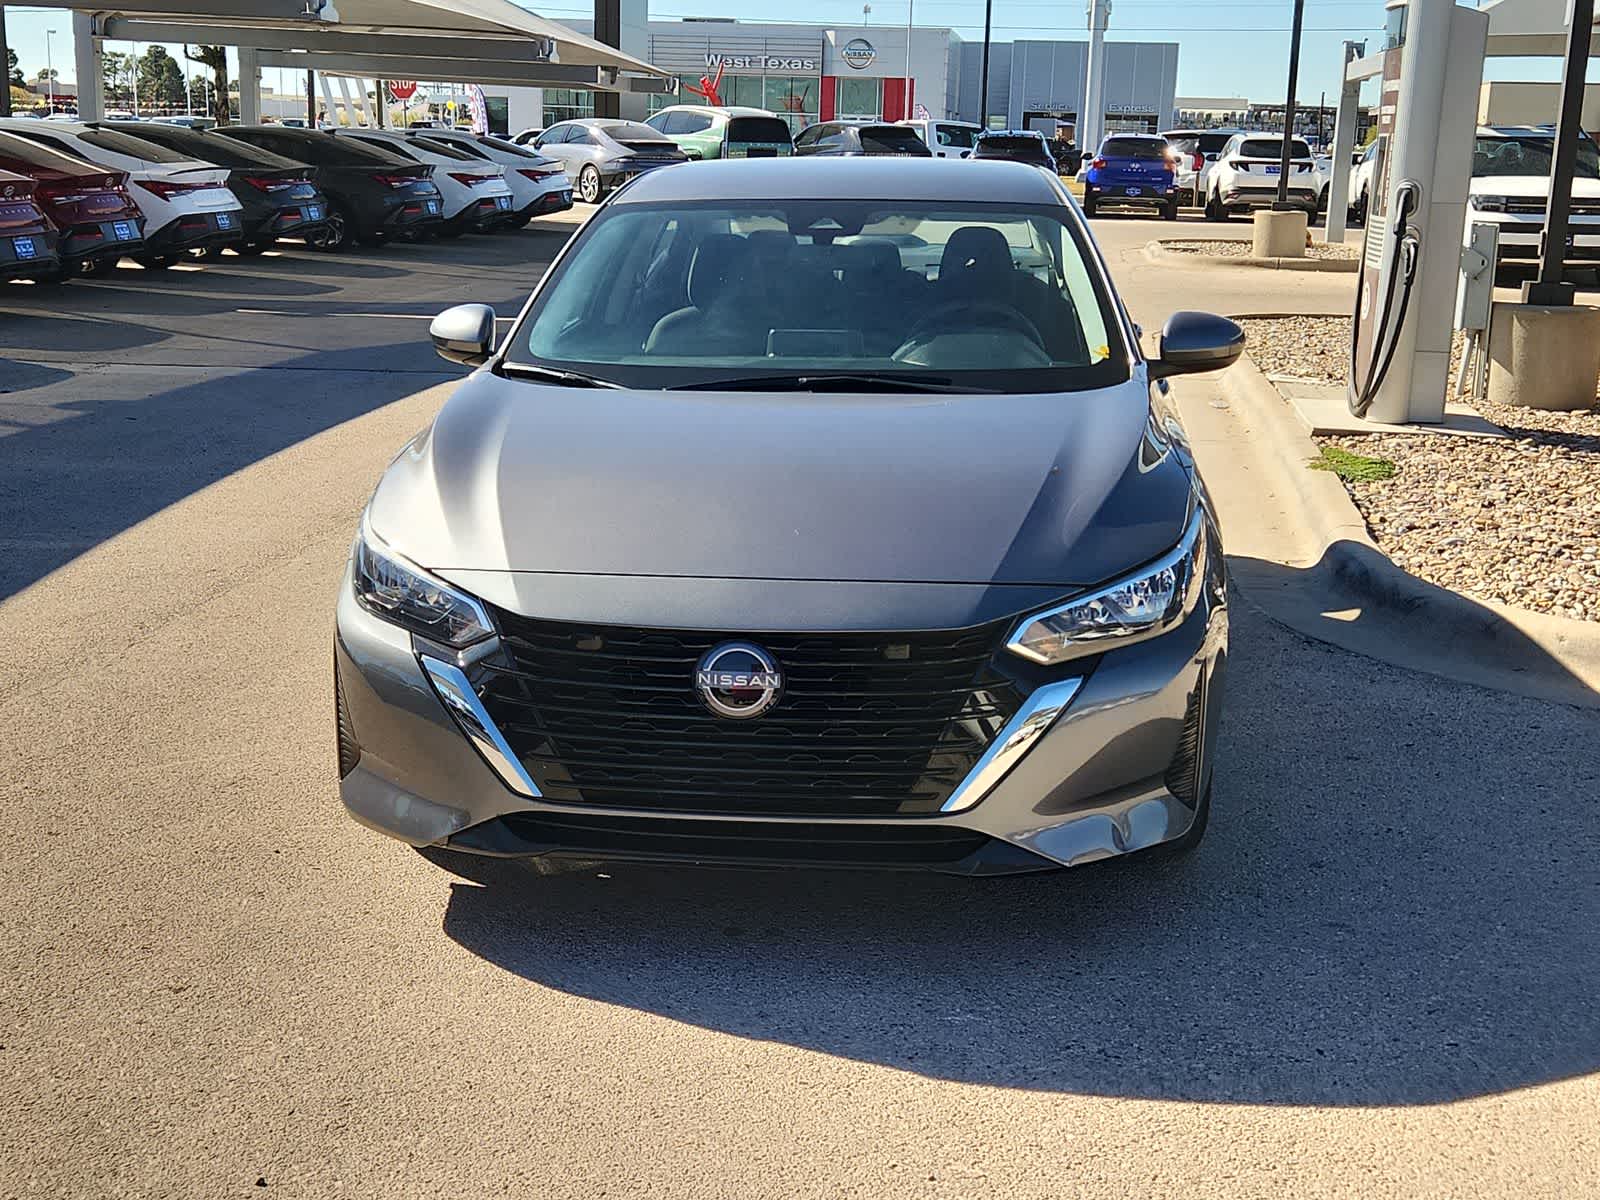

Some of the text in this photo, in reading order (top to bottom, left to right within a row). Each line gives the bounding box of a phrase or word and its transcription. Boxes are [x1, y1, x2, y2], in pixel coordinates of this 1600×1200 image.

[704, 54, 815, 70] West Texas
[391, 80, 416, 90] STOP
[1108, 103, 1155, 114] Express
[698, 672, 779, 687] NISSAN
